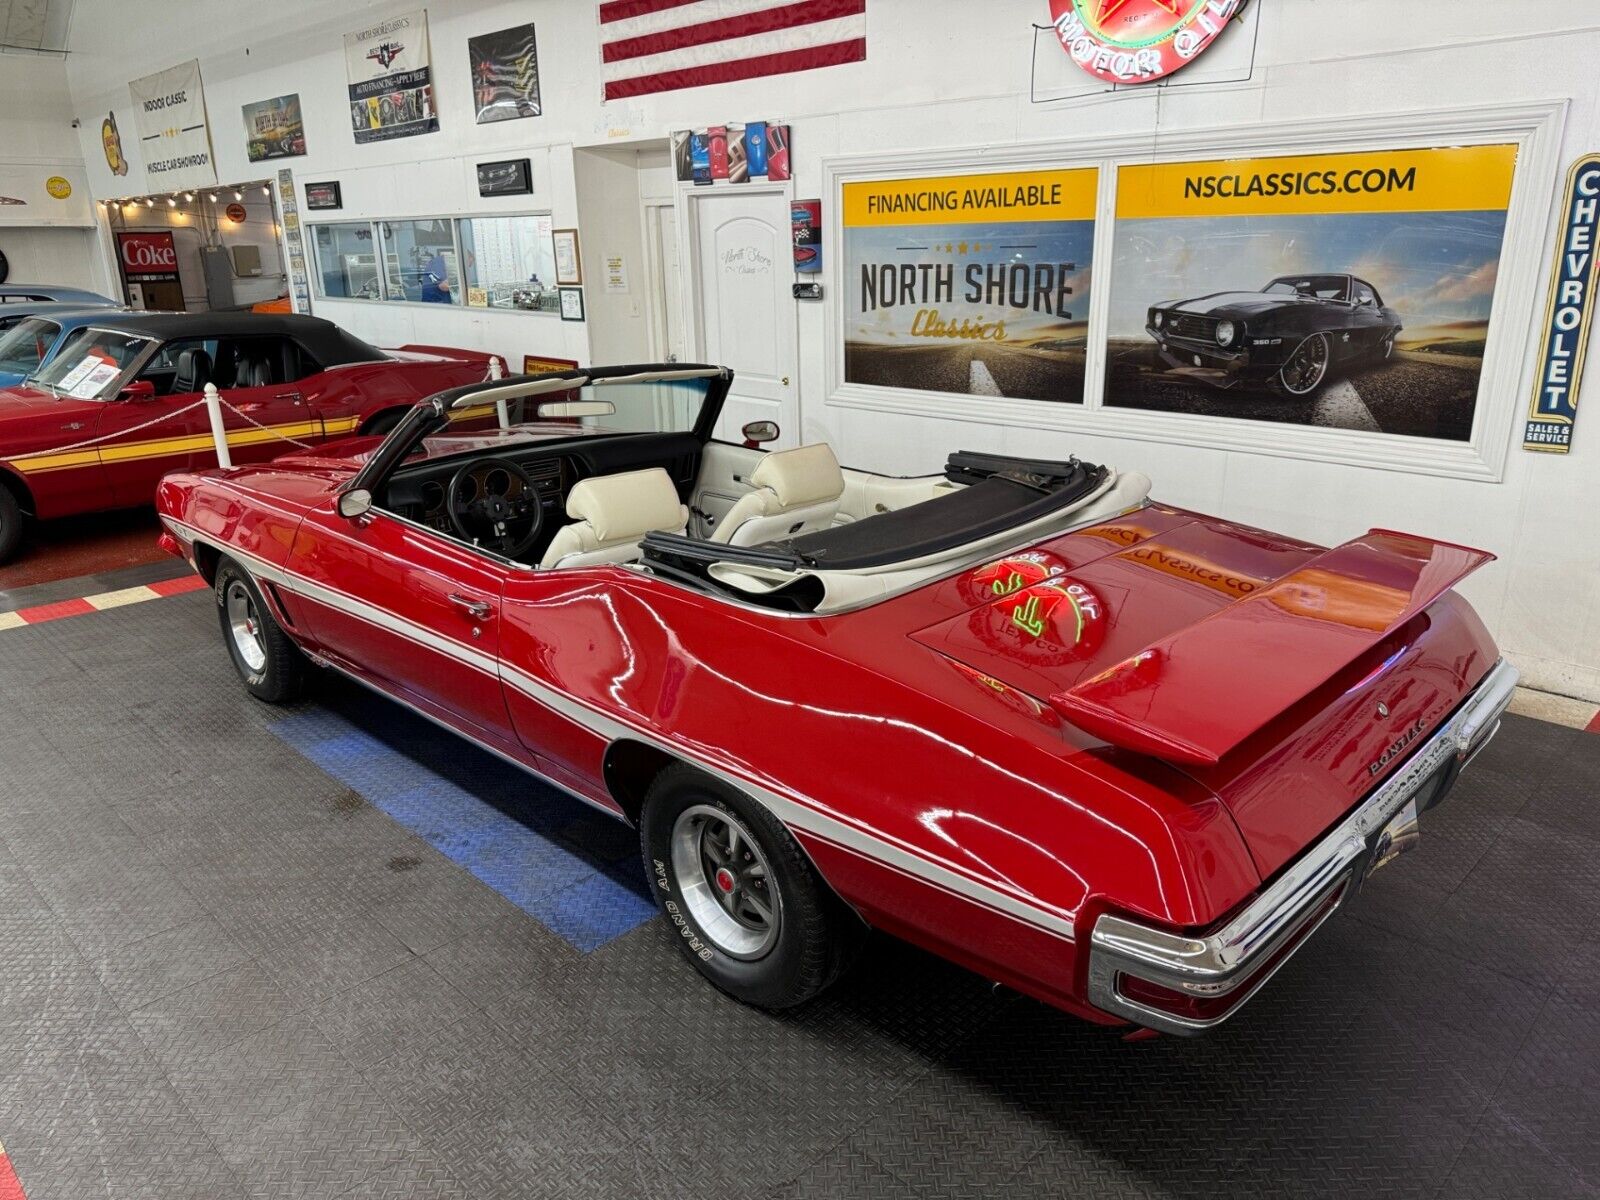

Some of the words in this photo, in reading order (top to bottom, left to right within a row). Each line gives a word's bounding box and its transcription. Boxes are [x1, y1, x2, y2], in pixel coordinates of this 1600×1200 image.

[1053, 11, 1164, 79] MOTOR
[1173, 0, 1238, 59] OIL
[143, 98, 166, 112] INDOOR
[165, 91, 188, 107] CLASSIC
[147, 160, 167, 174] MUSCLE
[166, 157, 178, 170] CAR
[1184, 167, 1417, 198] NSCLASSICS.COM
[868, 190, 958, 214] FINANCING
[961, 184, 1062, 209] AVAILABLE
[122, 239, 176, 266] Coke
[861, 263, 954, 313] NORTH
[964, 262, 1076, 321] SHORE
[1545, 170, 1600, 410] CHEVROLET
[910, 309, 1008, 341] Classics
[1526, 432, 1569, 444] SERVICE
[1528, 423, 1560, 434] SALES
[1561, 426, 1570, 435] &
[1369, 718, 1426, 776] PONTIAC
[653, 859, 670, 892] AM
[665, 900, 714, 962] GRAND
